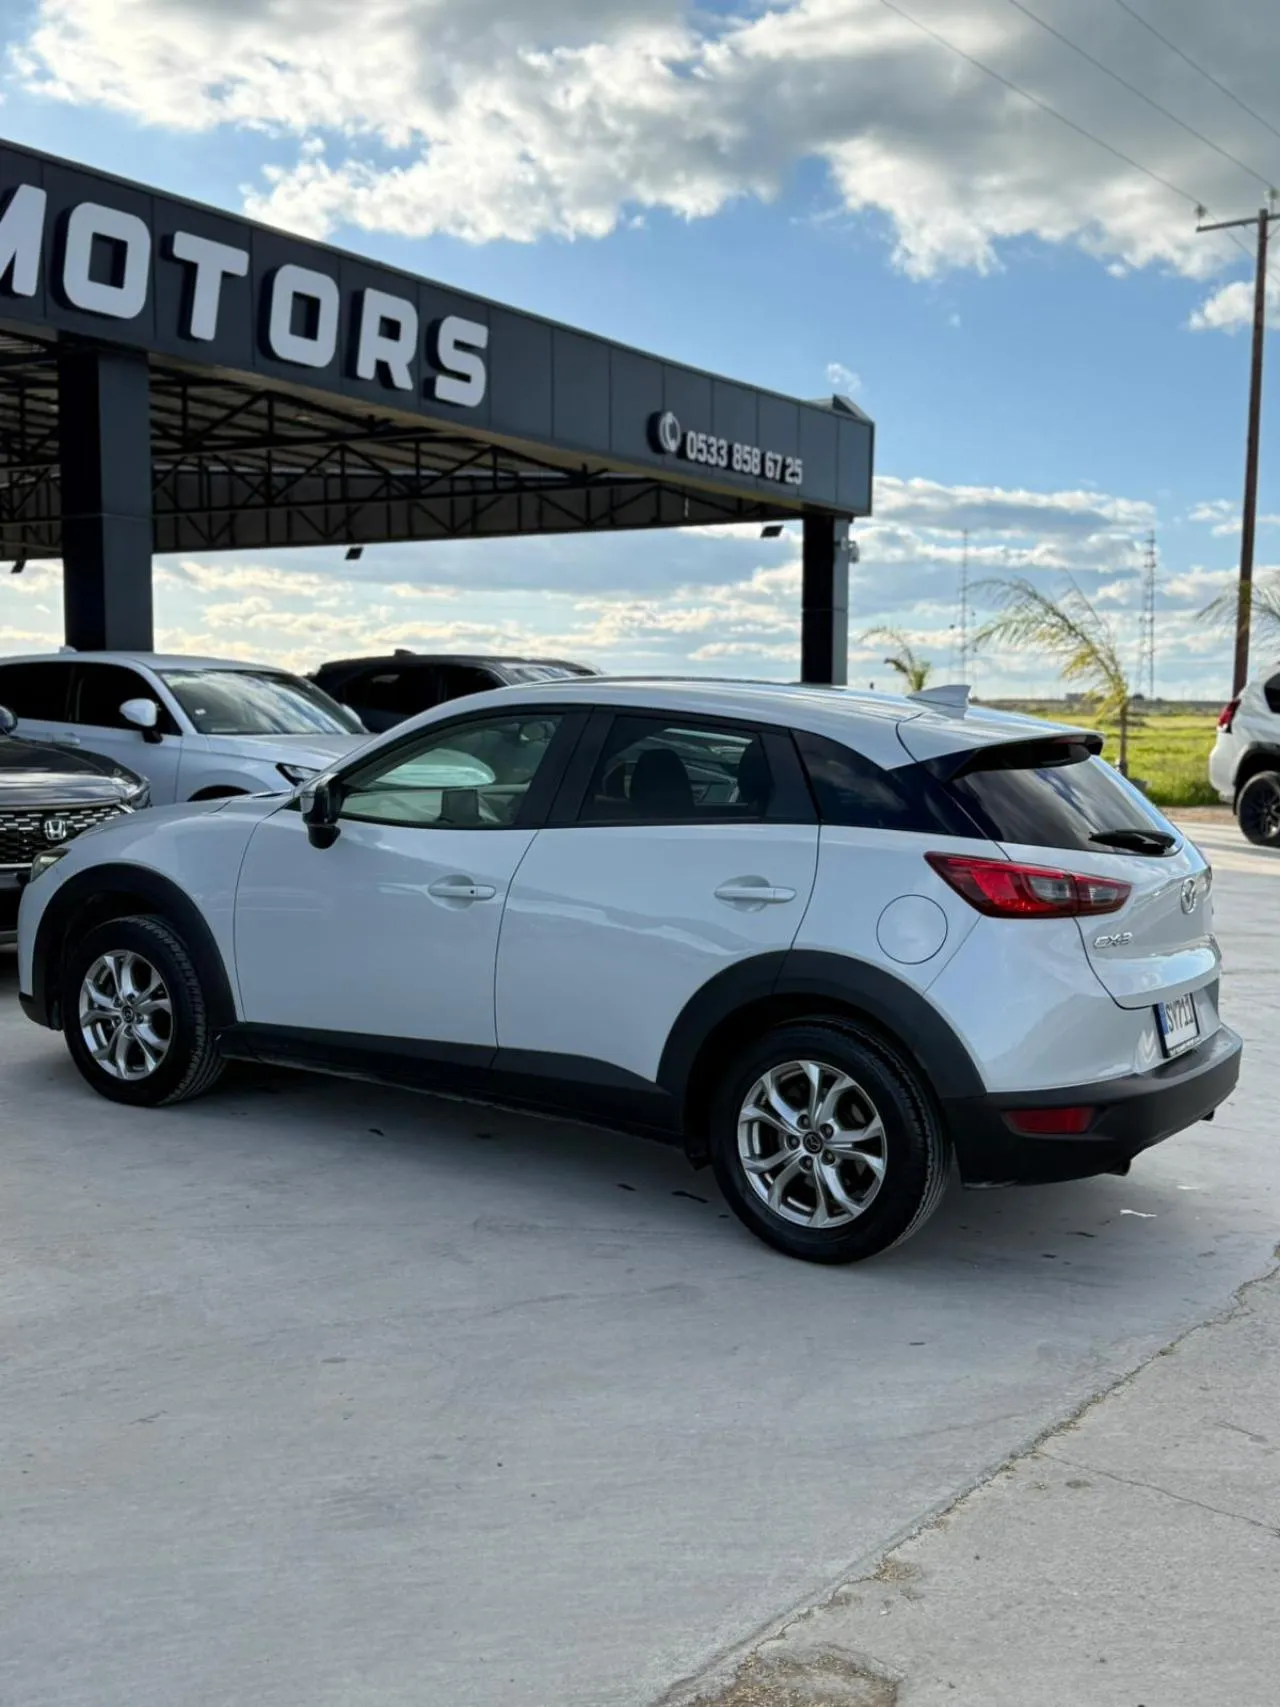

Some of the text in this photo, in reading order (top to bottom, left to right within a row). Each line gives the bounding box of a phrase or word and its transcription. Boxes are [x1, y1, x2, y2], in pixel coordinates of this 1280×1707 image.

[686, 430, 803, 485] 0533 858 67 25
